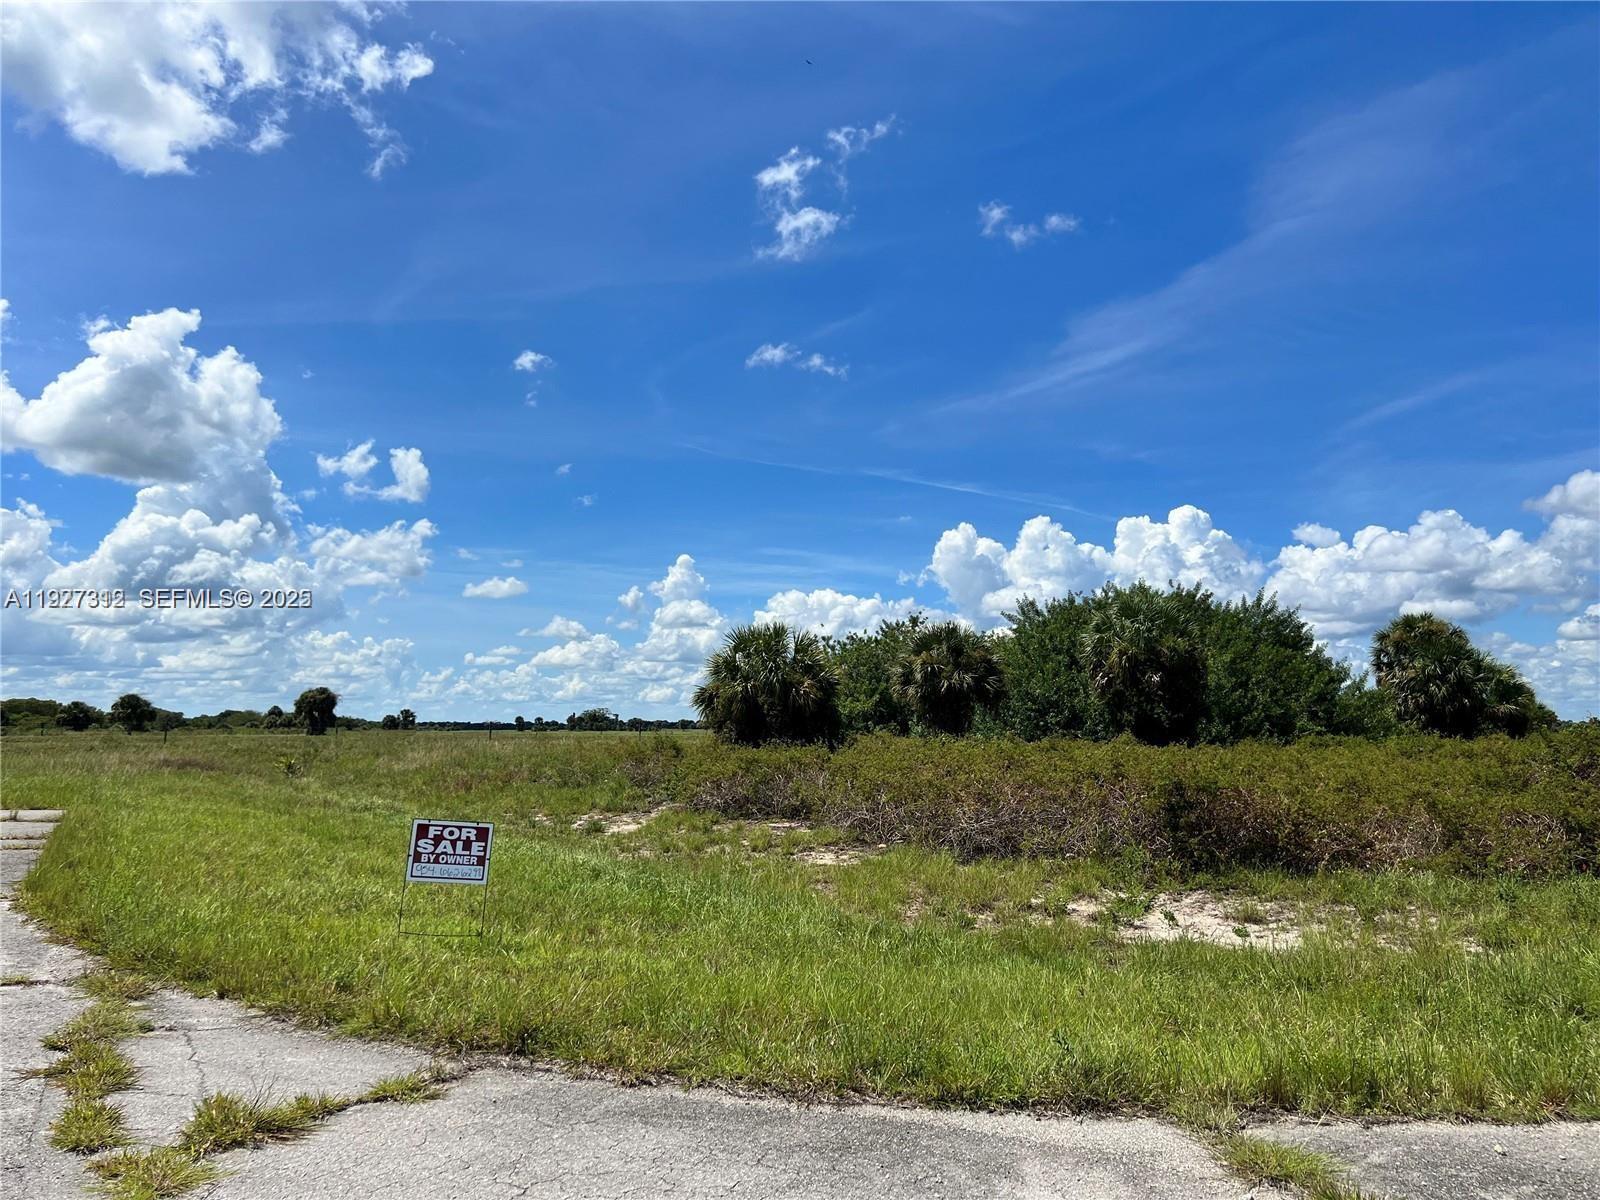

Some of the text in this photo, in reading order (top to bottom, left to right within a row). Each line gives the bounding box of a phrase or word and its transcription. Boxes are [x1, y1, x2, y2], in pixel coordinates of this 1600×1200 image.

[428, 826, 477, 840] FOR
[416, 839, 486, 856] SALE
[421, 854, 478, 865] BY OWNER
